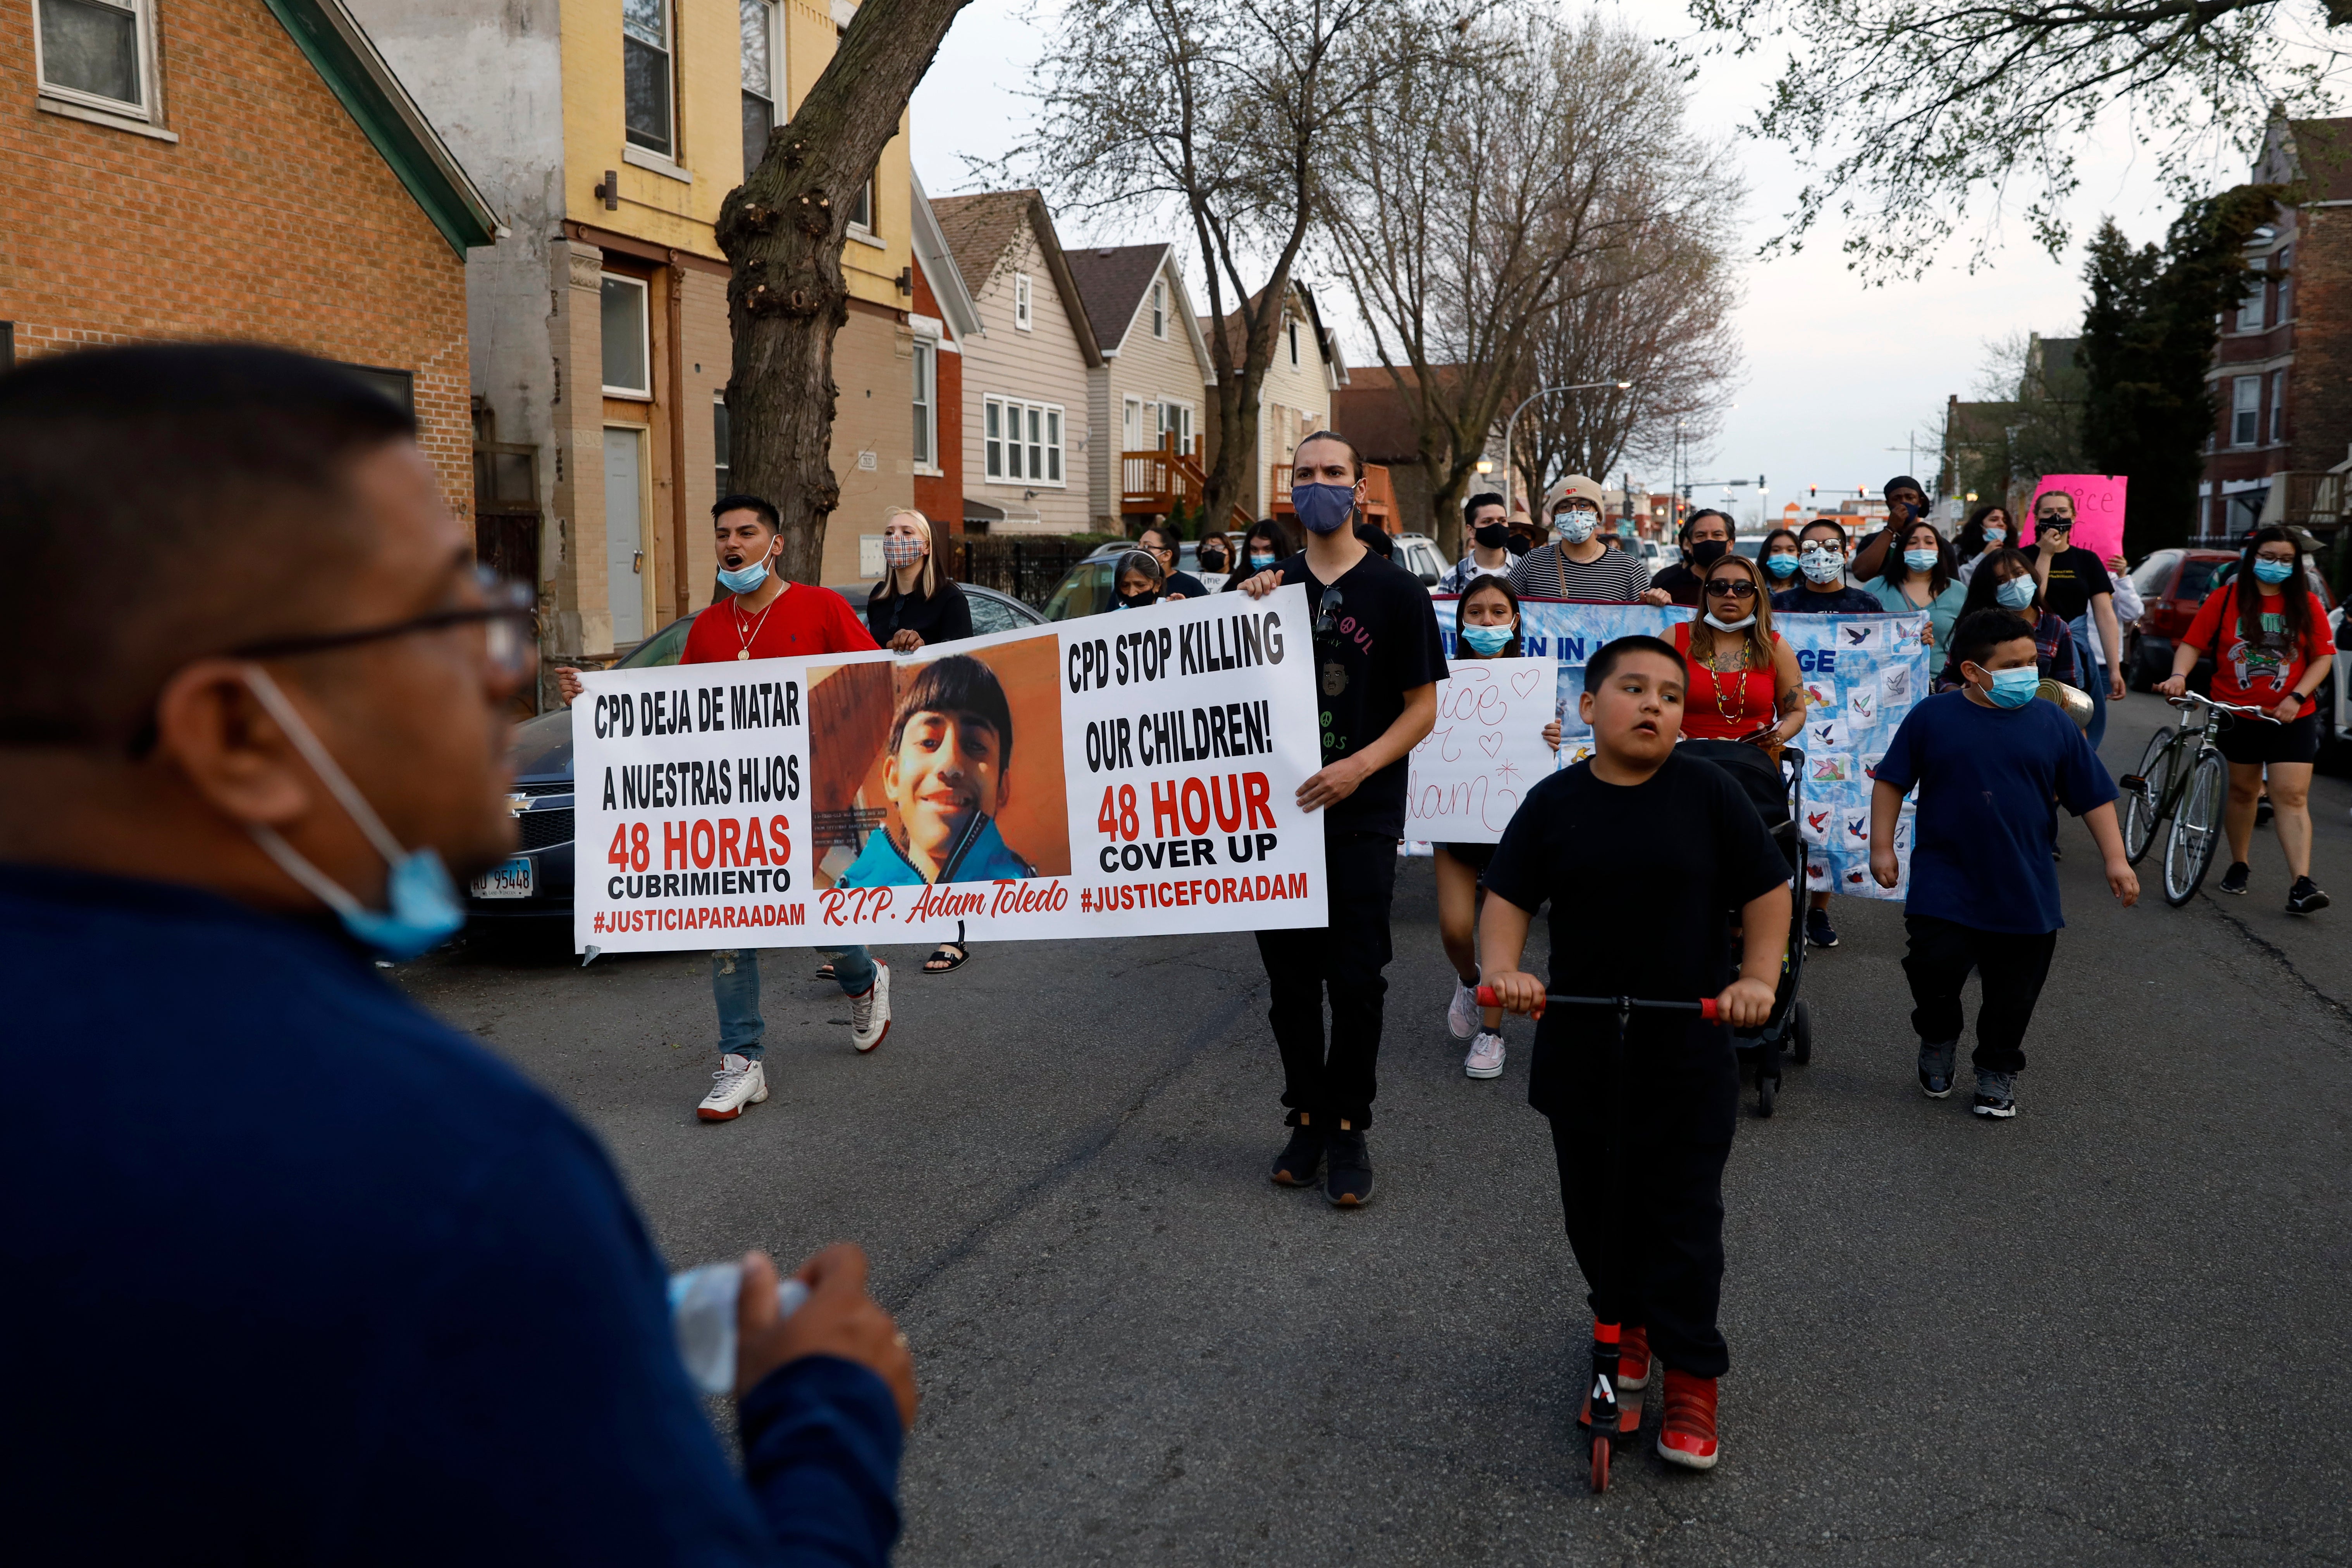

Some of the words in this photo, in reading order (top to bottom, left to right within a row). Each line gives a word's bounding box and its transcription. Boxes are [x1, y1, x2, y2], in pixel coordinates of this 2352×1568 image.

[1197, 573, 1220, 585] Time
[1068, 639, 1108, 694] CPD
[1116, 627, 1172, 686] STOP
[1179, 611, 1284, 676] KILLING
[1557, 637, 1584, 660] IN
[595, 694, 633, 739] CPD
[641, 690, 692, 736] DEJA
[699, 687, 724, 732] DE
[731, 682, 800, 730] MATAR
[1086, 717, 1133, 773] OUR
[1139, 700, 1274, 767] CHILDREN!
[603, 766, 617, 811] A
[623, 759, 731, 809] NUESTRAS
[738, 754, 799, 803] HIJOS
[1098, 784, 1139, 842] 48
[1151, 771, 1277, 838] HOUR
[608, 823, 650, 873] 48
[664, 815, 791, 870] HORAS
[1099, 838, 1217, 873] COVER
[1228, 833, 1277, 863] UP
[494, 869, 529, 890] 95448
[608, 868, 791, 900] CUBRIMIENTO
[1081, 873, 1308, 913] #JUSTICEFORADAM
[594, 903, 805, 933] #JUSTICIAPARAADAM
[819, 885, 896, 926] R.I.P.
[905, 883, 986, 924] Adam
[990, 879, 1068, 919] Toledo
